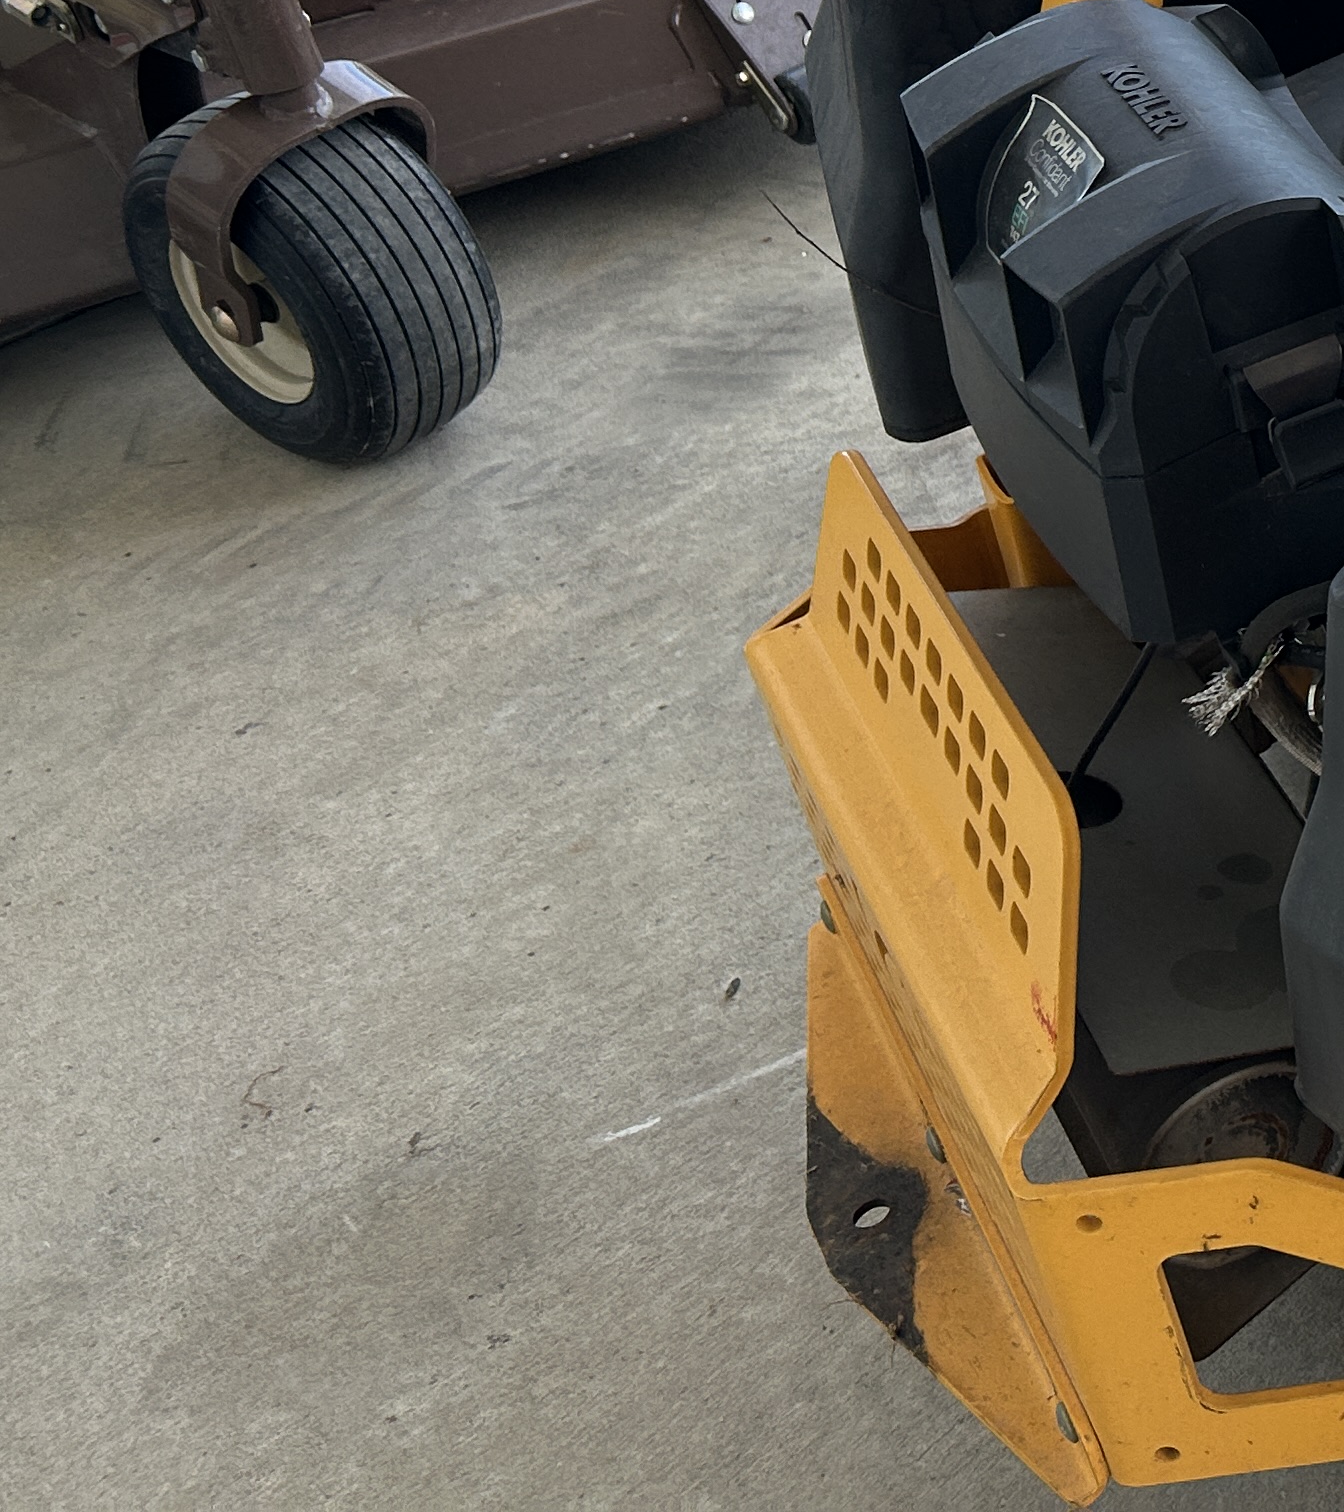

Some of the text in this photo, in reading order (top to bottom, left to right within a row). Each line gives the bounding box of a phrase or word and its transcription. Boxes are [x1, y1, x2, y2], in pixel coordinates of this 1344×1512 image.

[1100, 64, 1188, 135] KOHLER
[1029, 139, 1072, 192] Confidant
[1042, 119, 1087, 173] KOHLER
[1018, 180, 1040, 210] 27
